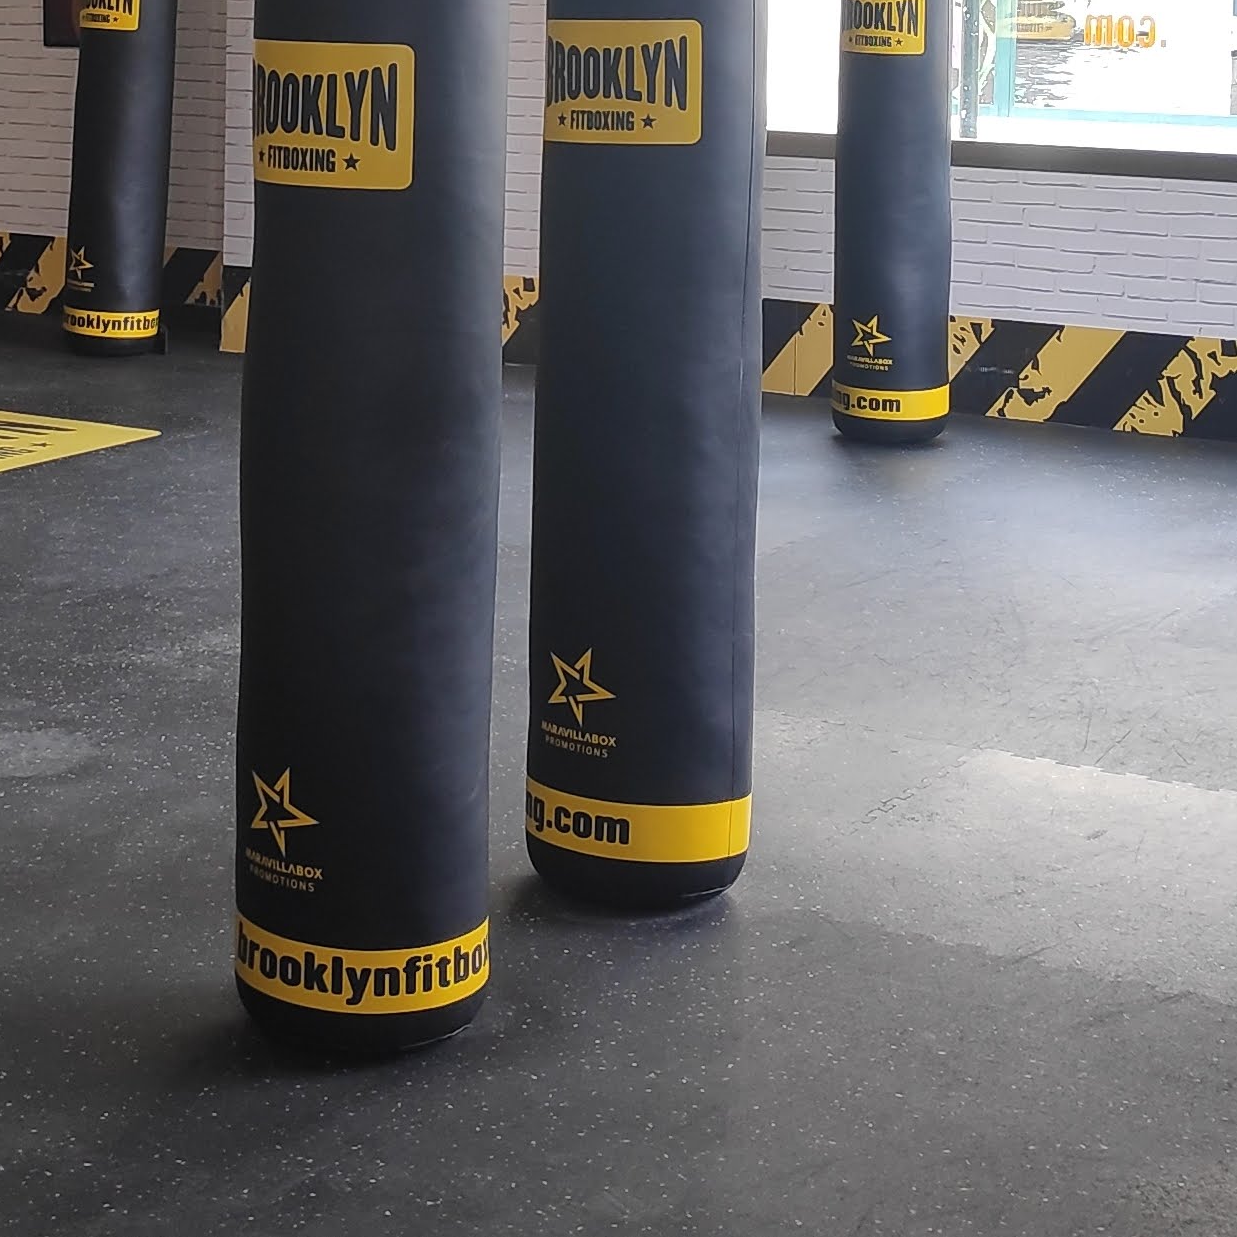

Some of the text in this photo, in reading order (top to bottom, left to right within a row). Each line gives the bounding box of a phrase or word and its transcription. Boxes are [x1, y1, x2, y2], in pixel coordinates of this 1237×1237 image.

[253, 59, 397, 151] ROOKLYN
[570, 110, 635, 131] FITBOXING
[267, 144, 336, 172] FITBOXING
[541, 720, 617, 747] MARAVILLABOX
[545, 734, 608, 758] PROMOTIONS
